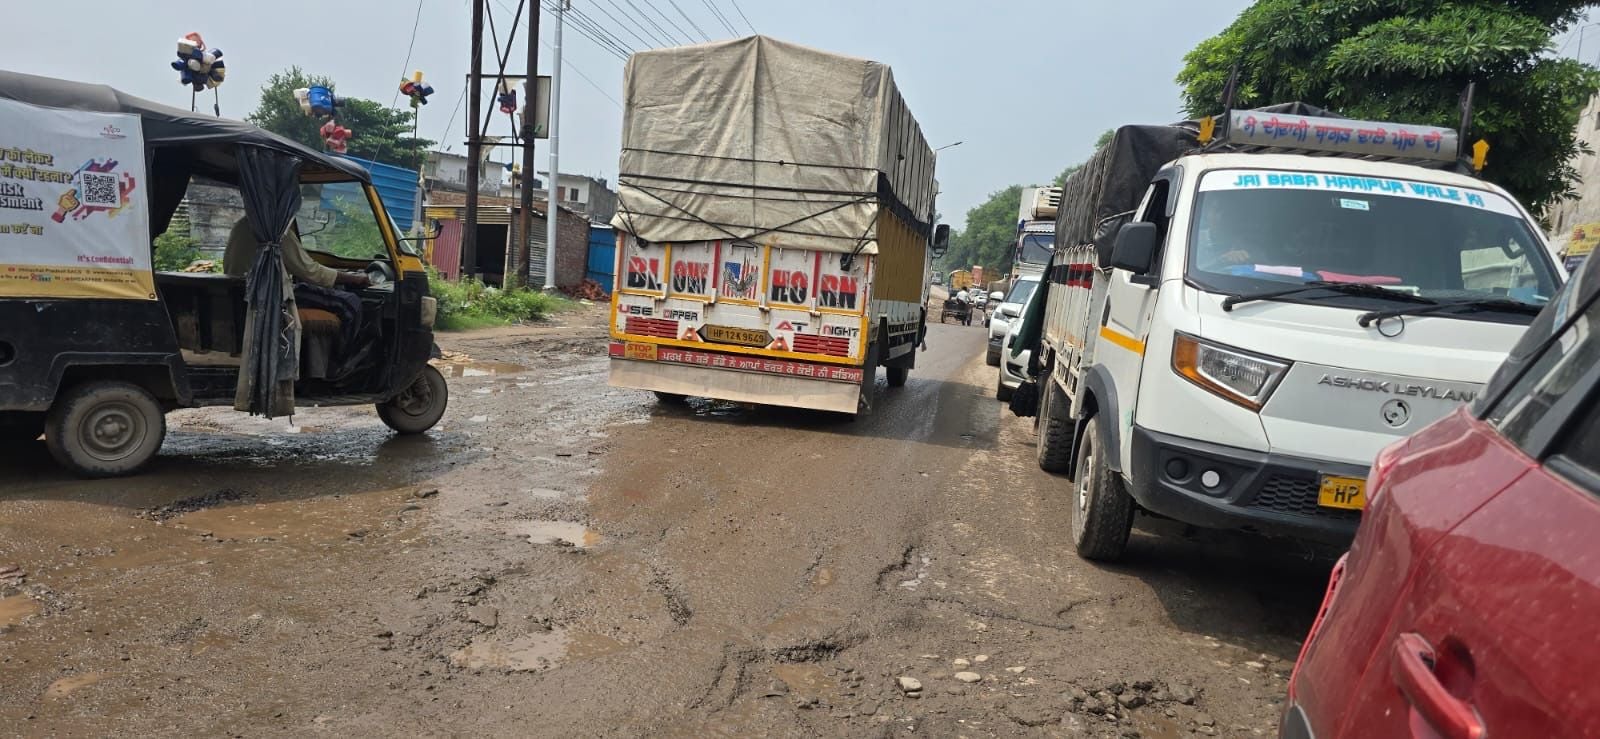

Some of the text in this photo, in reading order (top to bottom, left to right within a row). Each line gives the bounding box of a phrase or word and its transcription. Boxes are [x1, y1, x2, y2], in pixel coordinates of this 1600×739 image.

[1422, 130, 1444, 153] ਦੀ
[6, 147, 22, 162] को
[24, 148, 54, 166] लेकर
[1233, 174, 1260, 187] JAI
[1266, 174, 1318, 186] BABA
[1324, 176, 1406, 193] HARIPUR
[1410, 183, 1462, 200] WALE
[618, 304, 698, 321] USE DIPPER
[627, 345, 652, 353] STOP
[1317, 374, 1390, 394] ASHOK
[1334, 484, 1360, 504] HP
